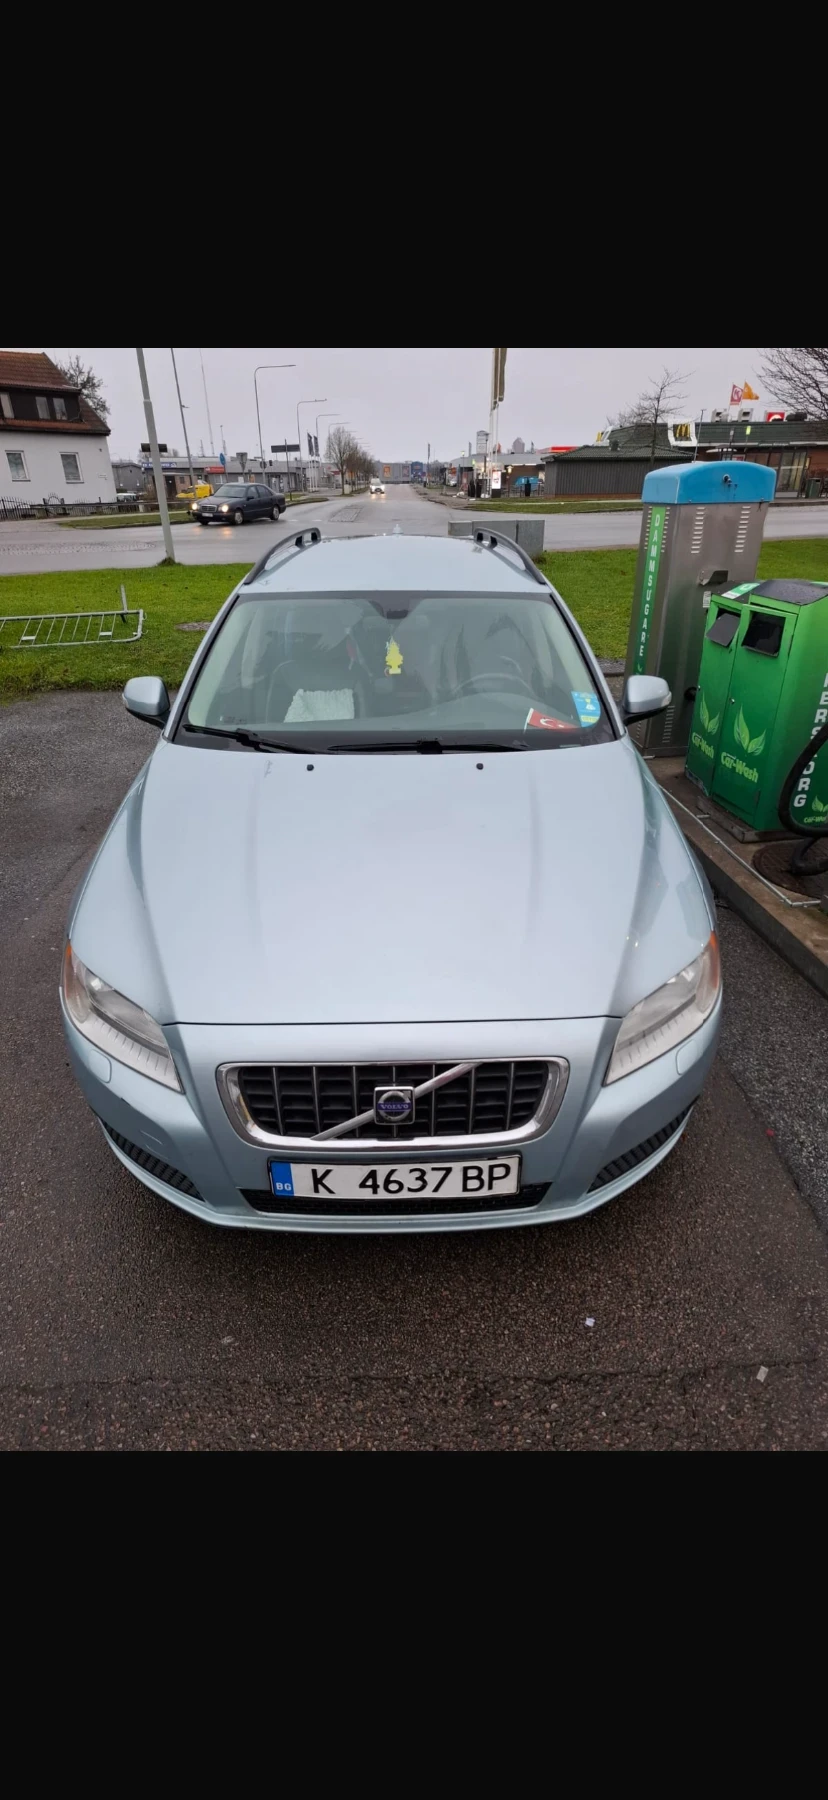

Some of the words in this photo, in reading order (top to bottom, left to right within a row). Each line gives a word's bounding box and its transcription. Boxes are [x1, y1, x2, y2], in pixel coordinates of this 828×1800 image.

[639, 514, 661, 657] DAMMSUGARE
[691, 732, 715, 759] Car-Wash
[793, 672, 828, 808] ERSORG
[720, 751, 759, 783] Car-Wash
[275, 1182, 292, 1192] BG
[311, 1168, 335, 1194] K
[358, 1166, 453, 1195] 4637
[461, 1163, 511, 1192] BP
